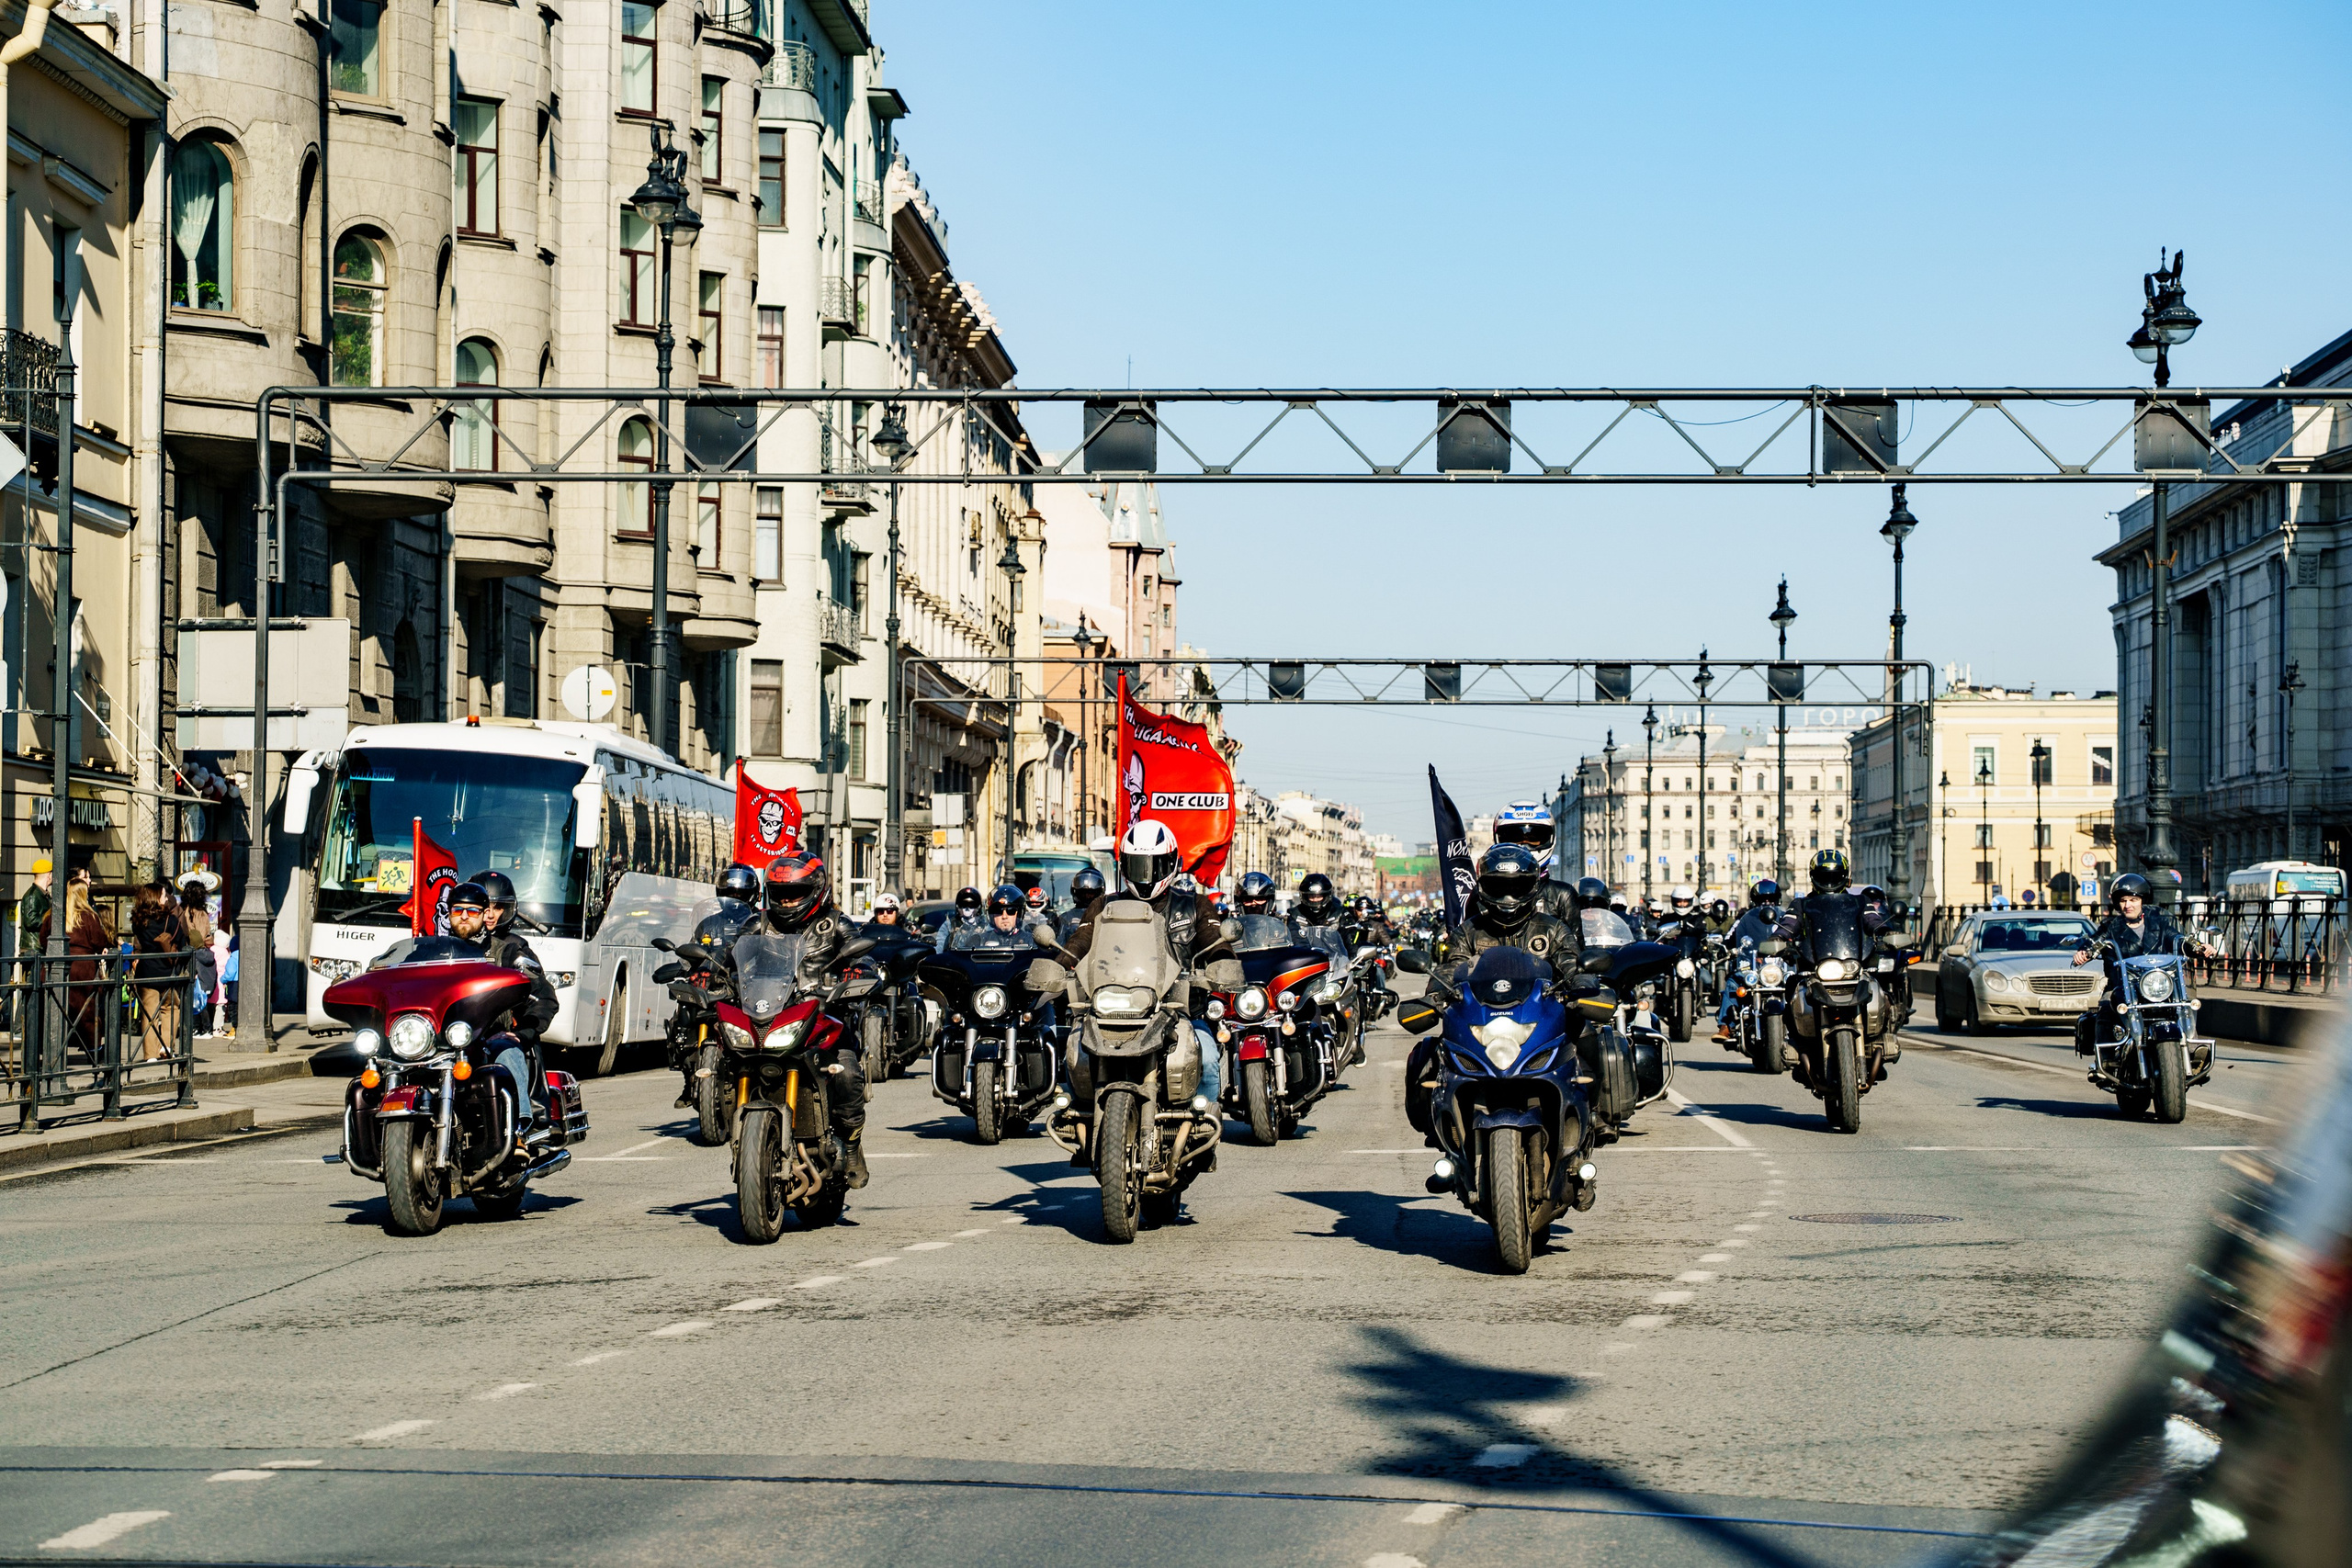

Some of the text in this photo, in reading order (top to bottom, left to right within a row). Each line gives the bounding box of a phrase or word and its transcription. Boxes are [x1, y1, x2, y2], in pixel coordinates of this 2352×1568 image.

[751, 794, 762, 806] THE
[1155, 795, 1225, 807] ONE CLUB
[74, 799, 110, 831] ПИЦЦА
[428, 869, 442, 883] THE
[336, 931, 376, 941] HIGER
